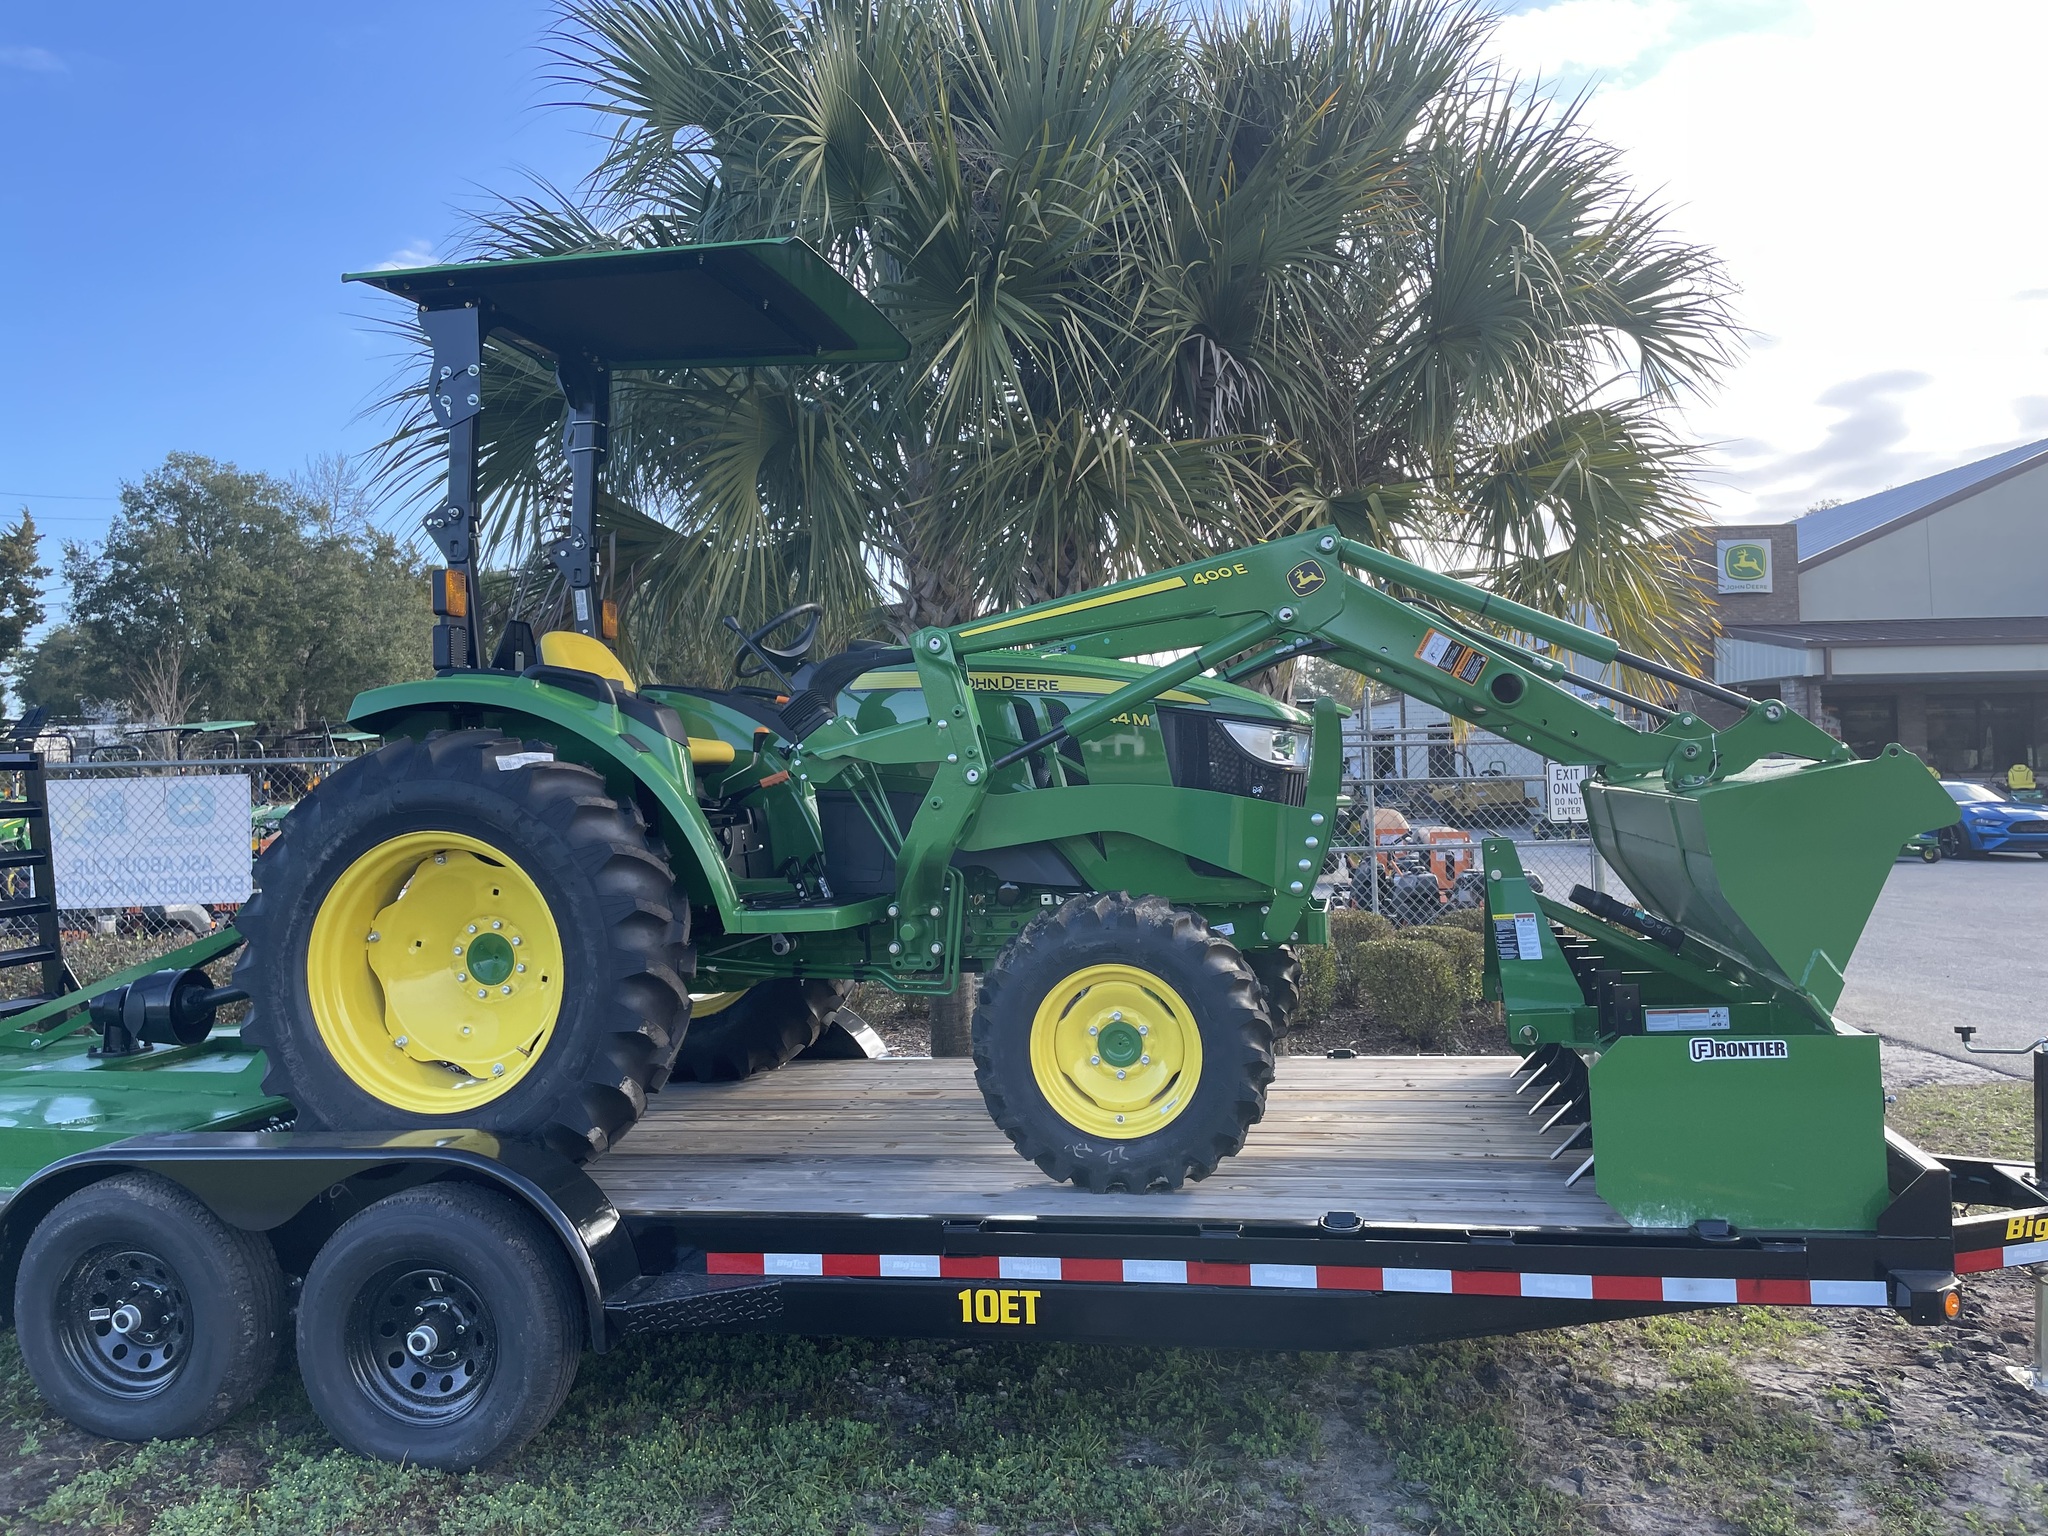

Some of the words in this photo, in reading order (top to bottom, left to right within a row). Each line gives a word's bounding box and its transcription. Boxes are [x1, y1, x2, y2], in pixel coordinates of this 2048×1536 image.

[1192, 567, 1233, 585] 400
[1232, 563, 1249, 575] E
[969, 677, 999, 690] OHN
[1001, 675, 1059, 691] DEERE
[1556, 768, 1579, 781] EXIT
[1553, 783, 1581, 795] ONLY
[1555, 797, 1565, 806] DO
[1568, 797, 1582, 805] NOT
[1557, 807, 1581, 815] ENTER
[1691, 1039, 1786, 1060] FRONTIER
[2005, 1215, 2048, 1242] Big
[957, 1288, 1041, 1325] 10ET
